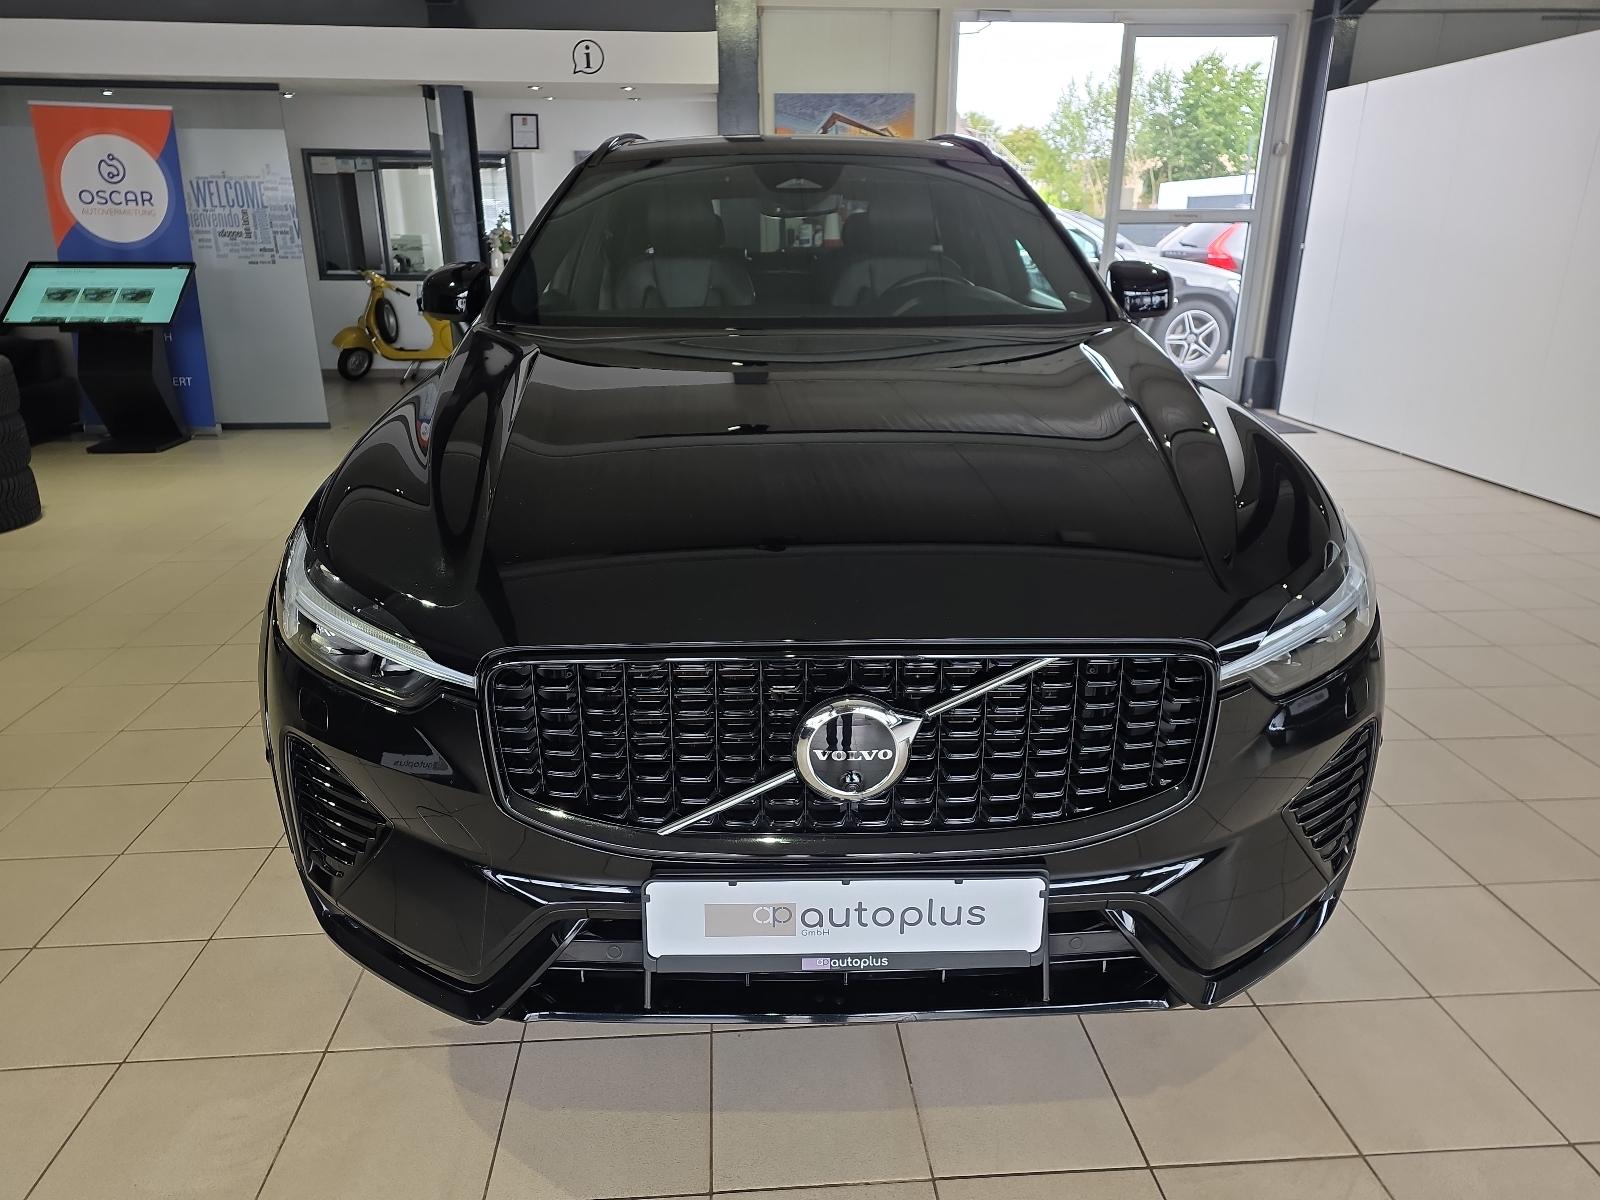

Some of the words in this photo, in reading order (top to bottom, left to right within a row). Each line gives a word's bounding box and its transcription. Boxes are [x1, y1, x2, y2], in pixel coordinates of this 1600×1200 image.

[78, 189, 155, 207] OSCAR
[189, 180, 268, 209] WELCOME
[189, 208, 241, 229] ienvenido
[172, 376, 193, 387] ERT
[812, 749, 894, 761] VOLVO
[800, 898, 986, 935] autoplus
[801, 928, 830, 937] GmbH
[830, 955, 889, 969] autoplus
